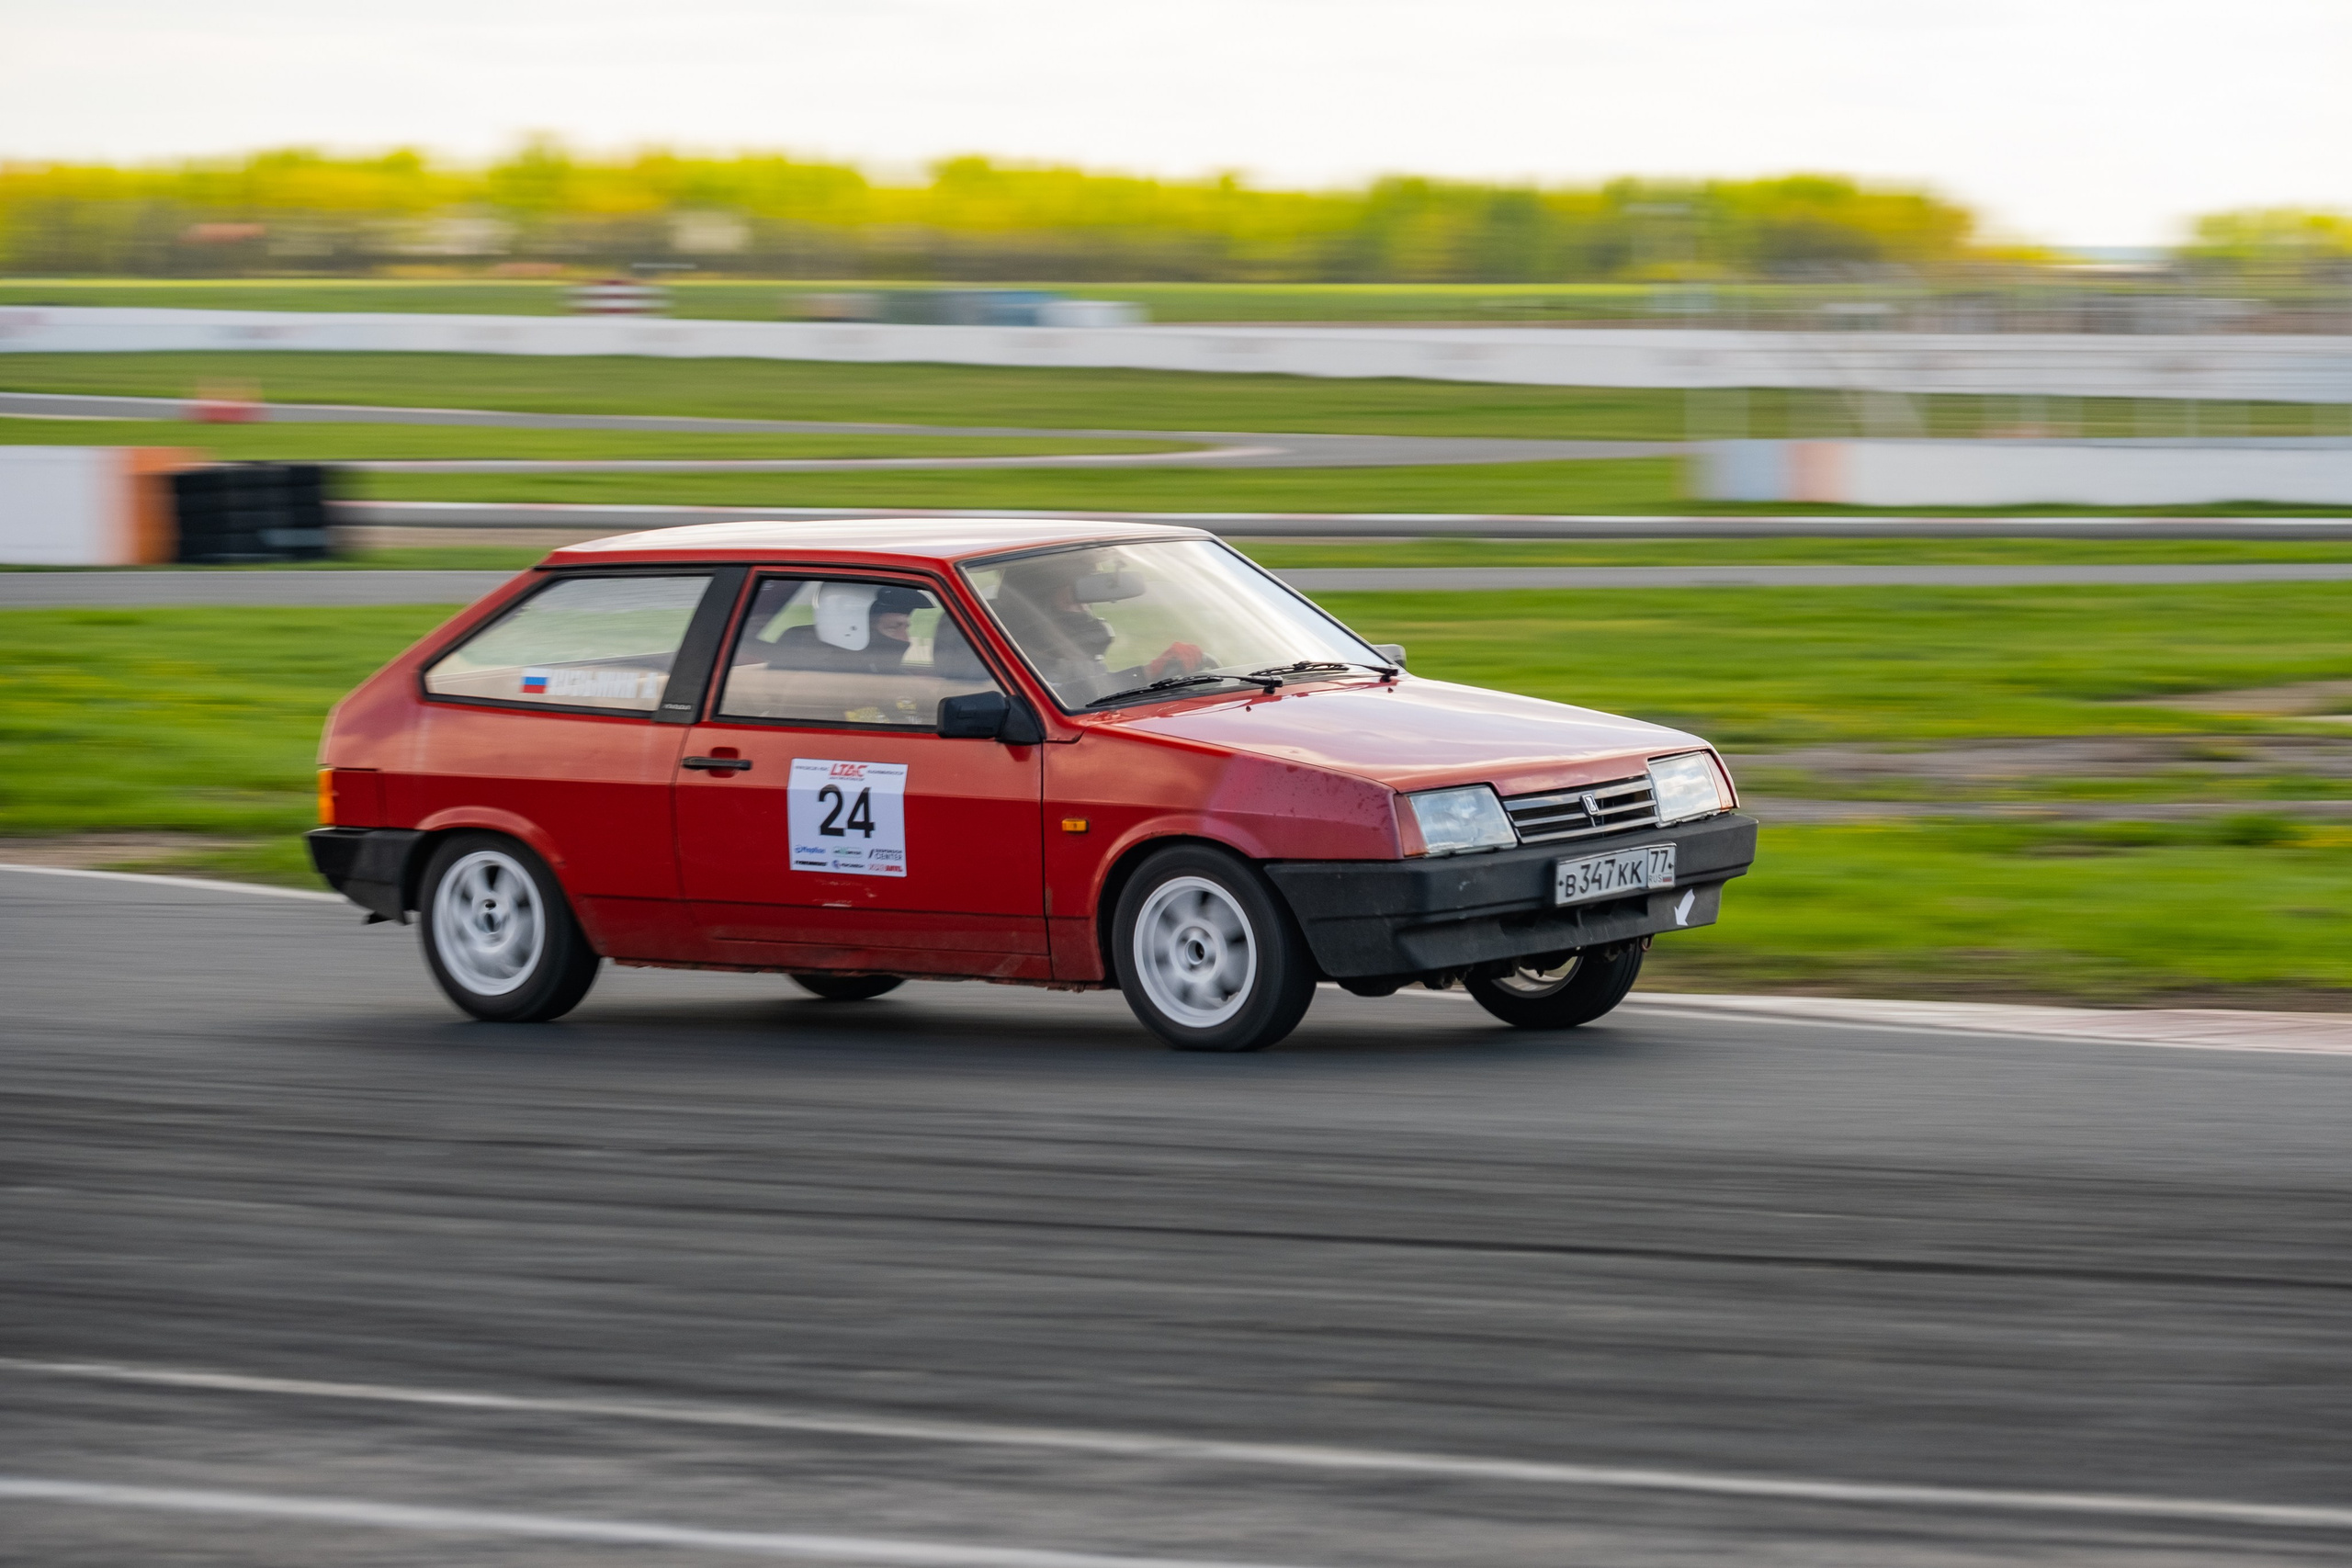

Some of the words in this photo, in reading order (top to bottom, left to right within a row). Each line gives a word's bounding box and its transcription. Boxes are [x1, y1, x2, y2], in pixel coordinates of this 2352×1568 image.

[818, 784, 876, 838] 24
[1650, 850, 1668, 874] 77
[1649, 874, 1663, 883] RUS
